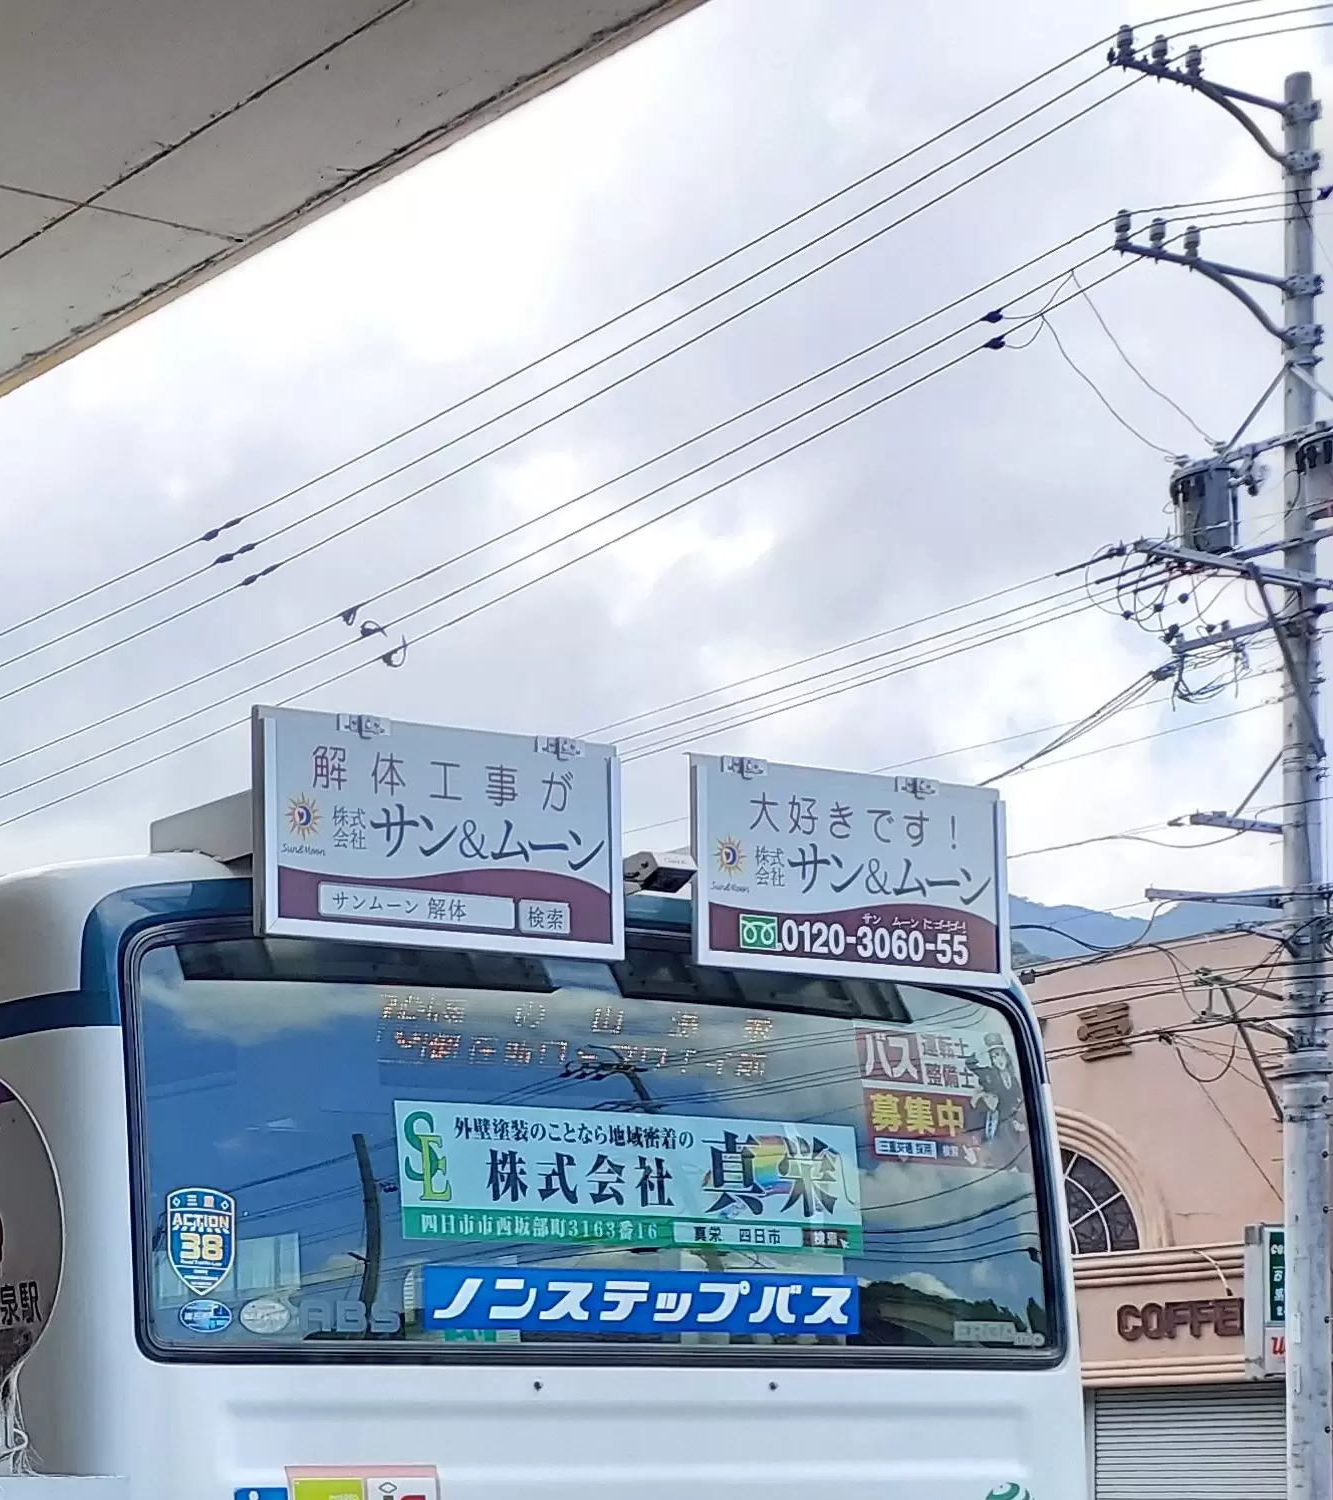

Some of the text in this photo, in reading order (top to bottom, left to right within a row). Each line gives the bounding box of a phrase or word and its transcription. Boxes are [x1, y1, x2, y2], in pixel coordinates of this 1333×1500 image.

[312, 744, 575, 813] 解体工事が
[332, 805, 366, 829] 株式
[332, 830, 367, 851] 会社
[755, 845, 785, 867] 株式
[755, 867, 785, 887] 会社
[332, 891, 467, 922] サンムーン 解体
[527, 906, 564, 931] 検索
[781, 919, 968, 966] 0120-3060-55
[865, 1033, 918, 1081] バス
[870, 1092, 964, 1137] 募集中
[454, 1116, 694, 1150] 外壁塗装のことなら地域密着の
[486, 1148, 675, 1208] 株式会社
[172, 1213, 230, 1229] ACTION
[739, 1228, 781, 1245] 四日市
[180, 1233, 223, 1261] 38
[300, 1300, 402, 1333] ABS
[433, 1276, 851, 1328] ノンステップバス
